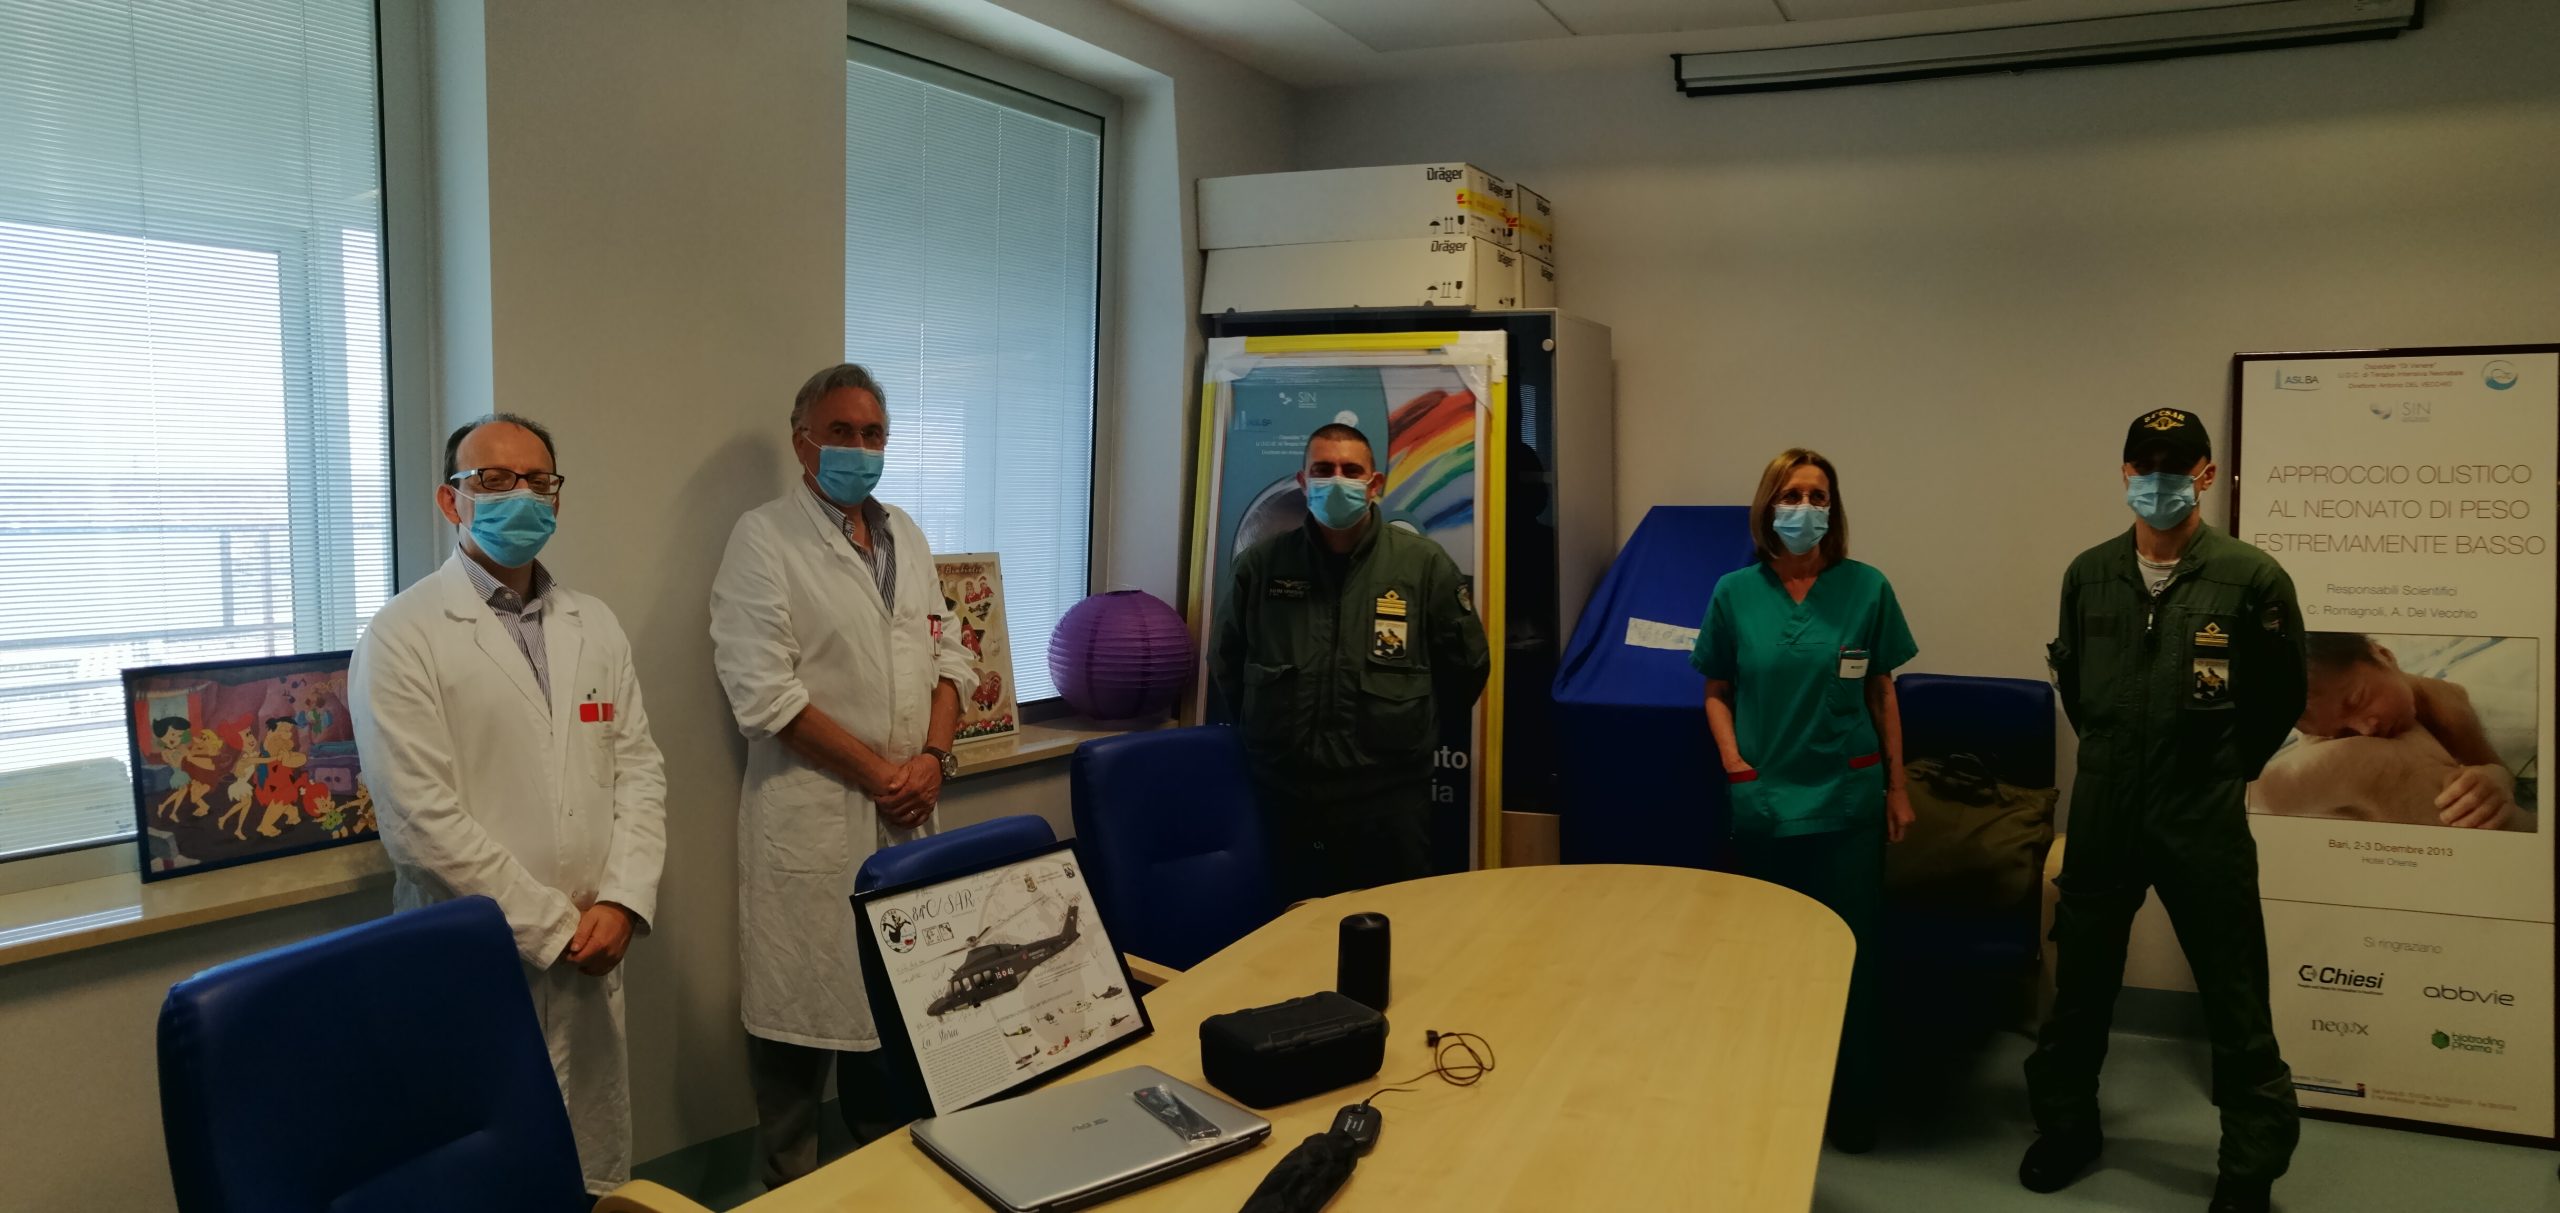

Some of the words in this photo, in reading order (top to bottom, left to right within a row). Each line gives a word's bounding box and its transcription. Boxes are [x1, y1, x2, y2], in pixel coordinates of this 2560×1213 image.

[1427, 167, 1464, 182] Dräger
[1431, 240, 1468, 254] Dräger
[1297, 391, 1317, 403] SIN
[2402, 402, 2432, 416] SIN
[2266, 465, 2410, 485] APPROCCIO
[2416, 464, 2532, 485] OLISTICO
[2268, 500, 2297, 518] AL
[2303, 499, 2422, 519] NEONATO
[2429, 500, 2452, 519] DI
[2460, 499, 2531, 520] PESO
[2254, 533, 2449, 554] ESTREMAMENTE
[2455, 535, 2546, 555] BASSO
[2326, 583, 2398, 596] Responsabili
[2306, 604, 2319, 616] C.
[2391, 607, 2402, 617] A.
[2407, 607, 2427, 618] Del
[2430, 608, 2478, 619] Vecchio
[2353, 841, 2372, 851] 2-3
[2374, 842, 2424, 855] Dicembre
[2427, 846, 2454, 857] 2013
[2363, 936, 2375, 948] Si
[2378, 939, 2443, 954] ringraziano
[2319, 967, 2385, 989] Chiesi
[2423, 984, 2515, 1007] abbvie
